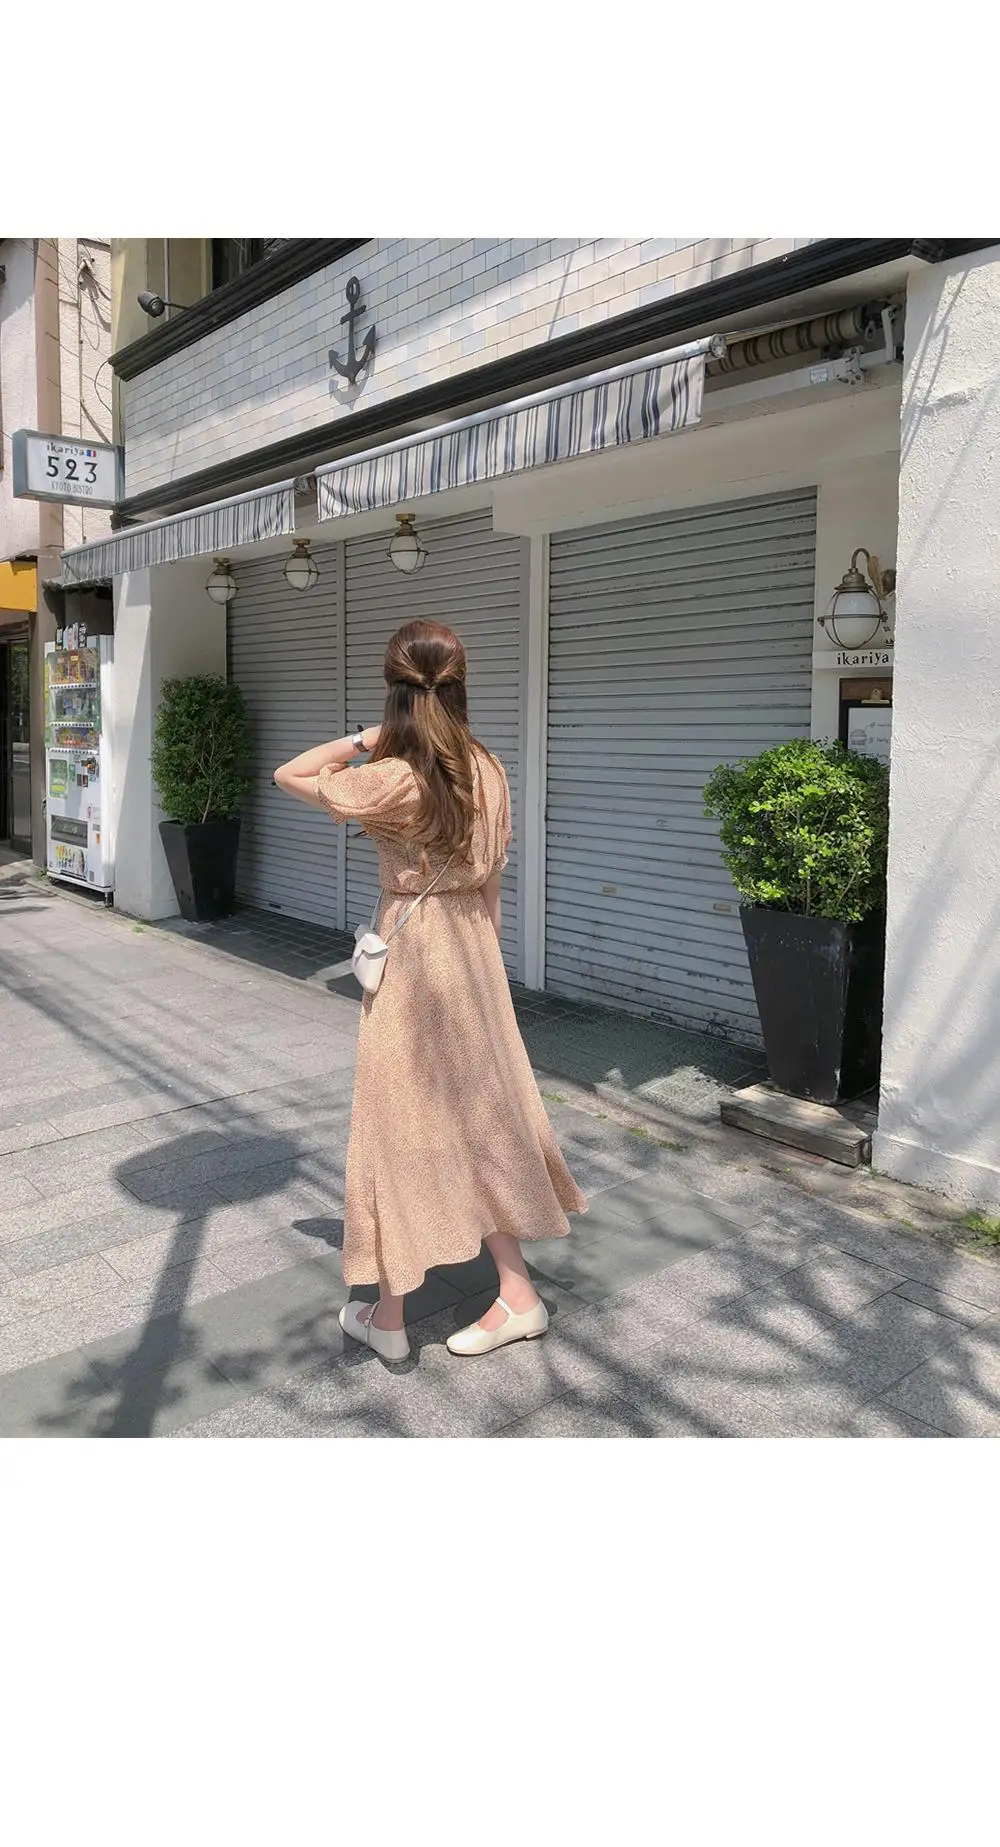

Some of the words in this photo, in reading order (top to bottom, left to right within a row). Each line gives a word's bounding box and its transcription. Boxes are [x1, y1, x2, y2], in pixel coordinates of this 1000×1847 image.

[47, 442, 84, 455] ikariya
[46, 456, 98, 483] 523
[52, 481, 71, 492] KYOTO
[837, 651, 889, 665] ikariya
